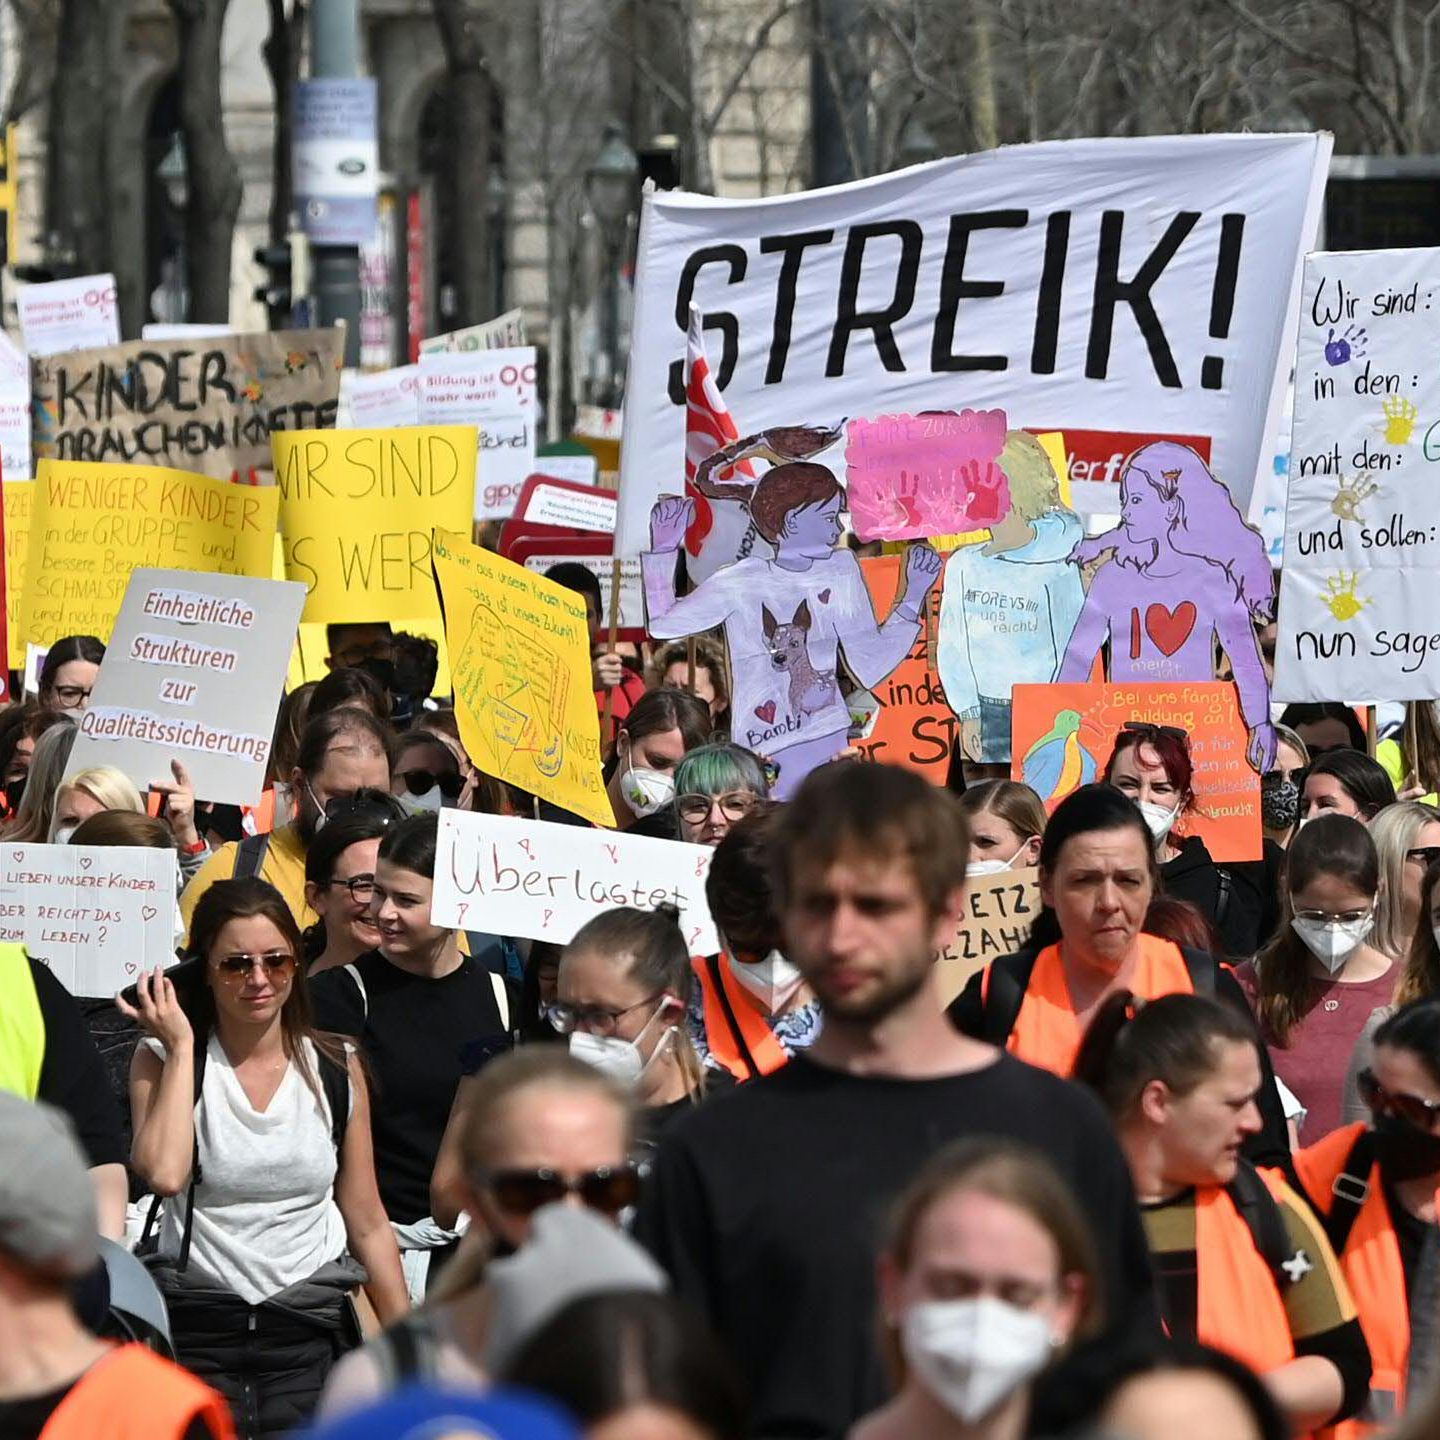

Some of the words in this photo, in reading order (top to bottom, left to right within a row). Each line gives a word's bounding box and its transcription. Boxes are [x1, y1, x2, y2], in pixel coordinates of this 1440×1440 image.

[666, 207, 1247, 406] STREIK!
[1312, 277, 1361, 328] Wir
[57, 350, 236, 426] KINDER
[1313, 376, 1336, 401] in
[345, 434, 459, 500] SIND
[1299, 446, 1343, 478] mit
[47, 475, 149, 513] WENIGER
[159, 479, 262, 533] KINDER
[44, 526, 61, 542] in
[63, 522, 90, 545] der
[92, 514, 193, 553] GRUPPE
[202, 536, 236, 561] und
[1297, 516, 1344, 557] und
[41, 549, 96, 574] bessere
[32, 602, 64, 624] und
[143, 591, 254, 628] Einheitliche
[980, 611, 1006, 622] uns
[1129, 606, 1141, 660] I
[1295, 626, 1356, 661] nun
[130, 636, 236, 671] Strukturen
[162, 680, 197, 702] zur
[1112, 690, 1140, 708] Bei
[1148, 691, 1177, 705] uns
[1181, 687, 1234, 714] fängt
[80, 711, 270, 763] Qualitätssicherung
[745, 714, 802, 748] Bambi
[1130, 709, 1196, 733] Bildung
[6, 871, 52, 885] LIEBEN
[57, 875, 107, 889] UNSERE
[107, 871, 157, 892] KINDER
[450, 826, 690, 913] Überlastet
[37, 905, 91, 921] REICHT
[92, 908, 123, 924] DAS
[0, 929, 25, 941] ZUM
[41, 928, 91, 945] LEBEN
[97, 925, 109, 948] ?
